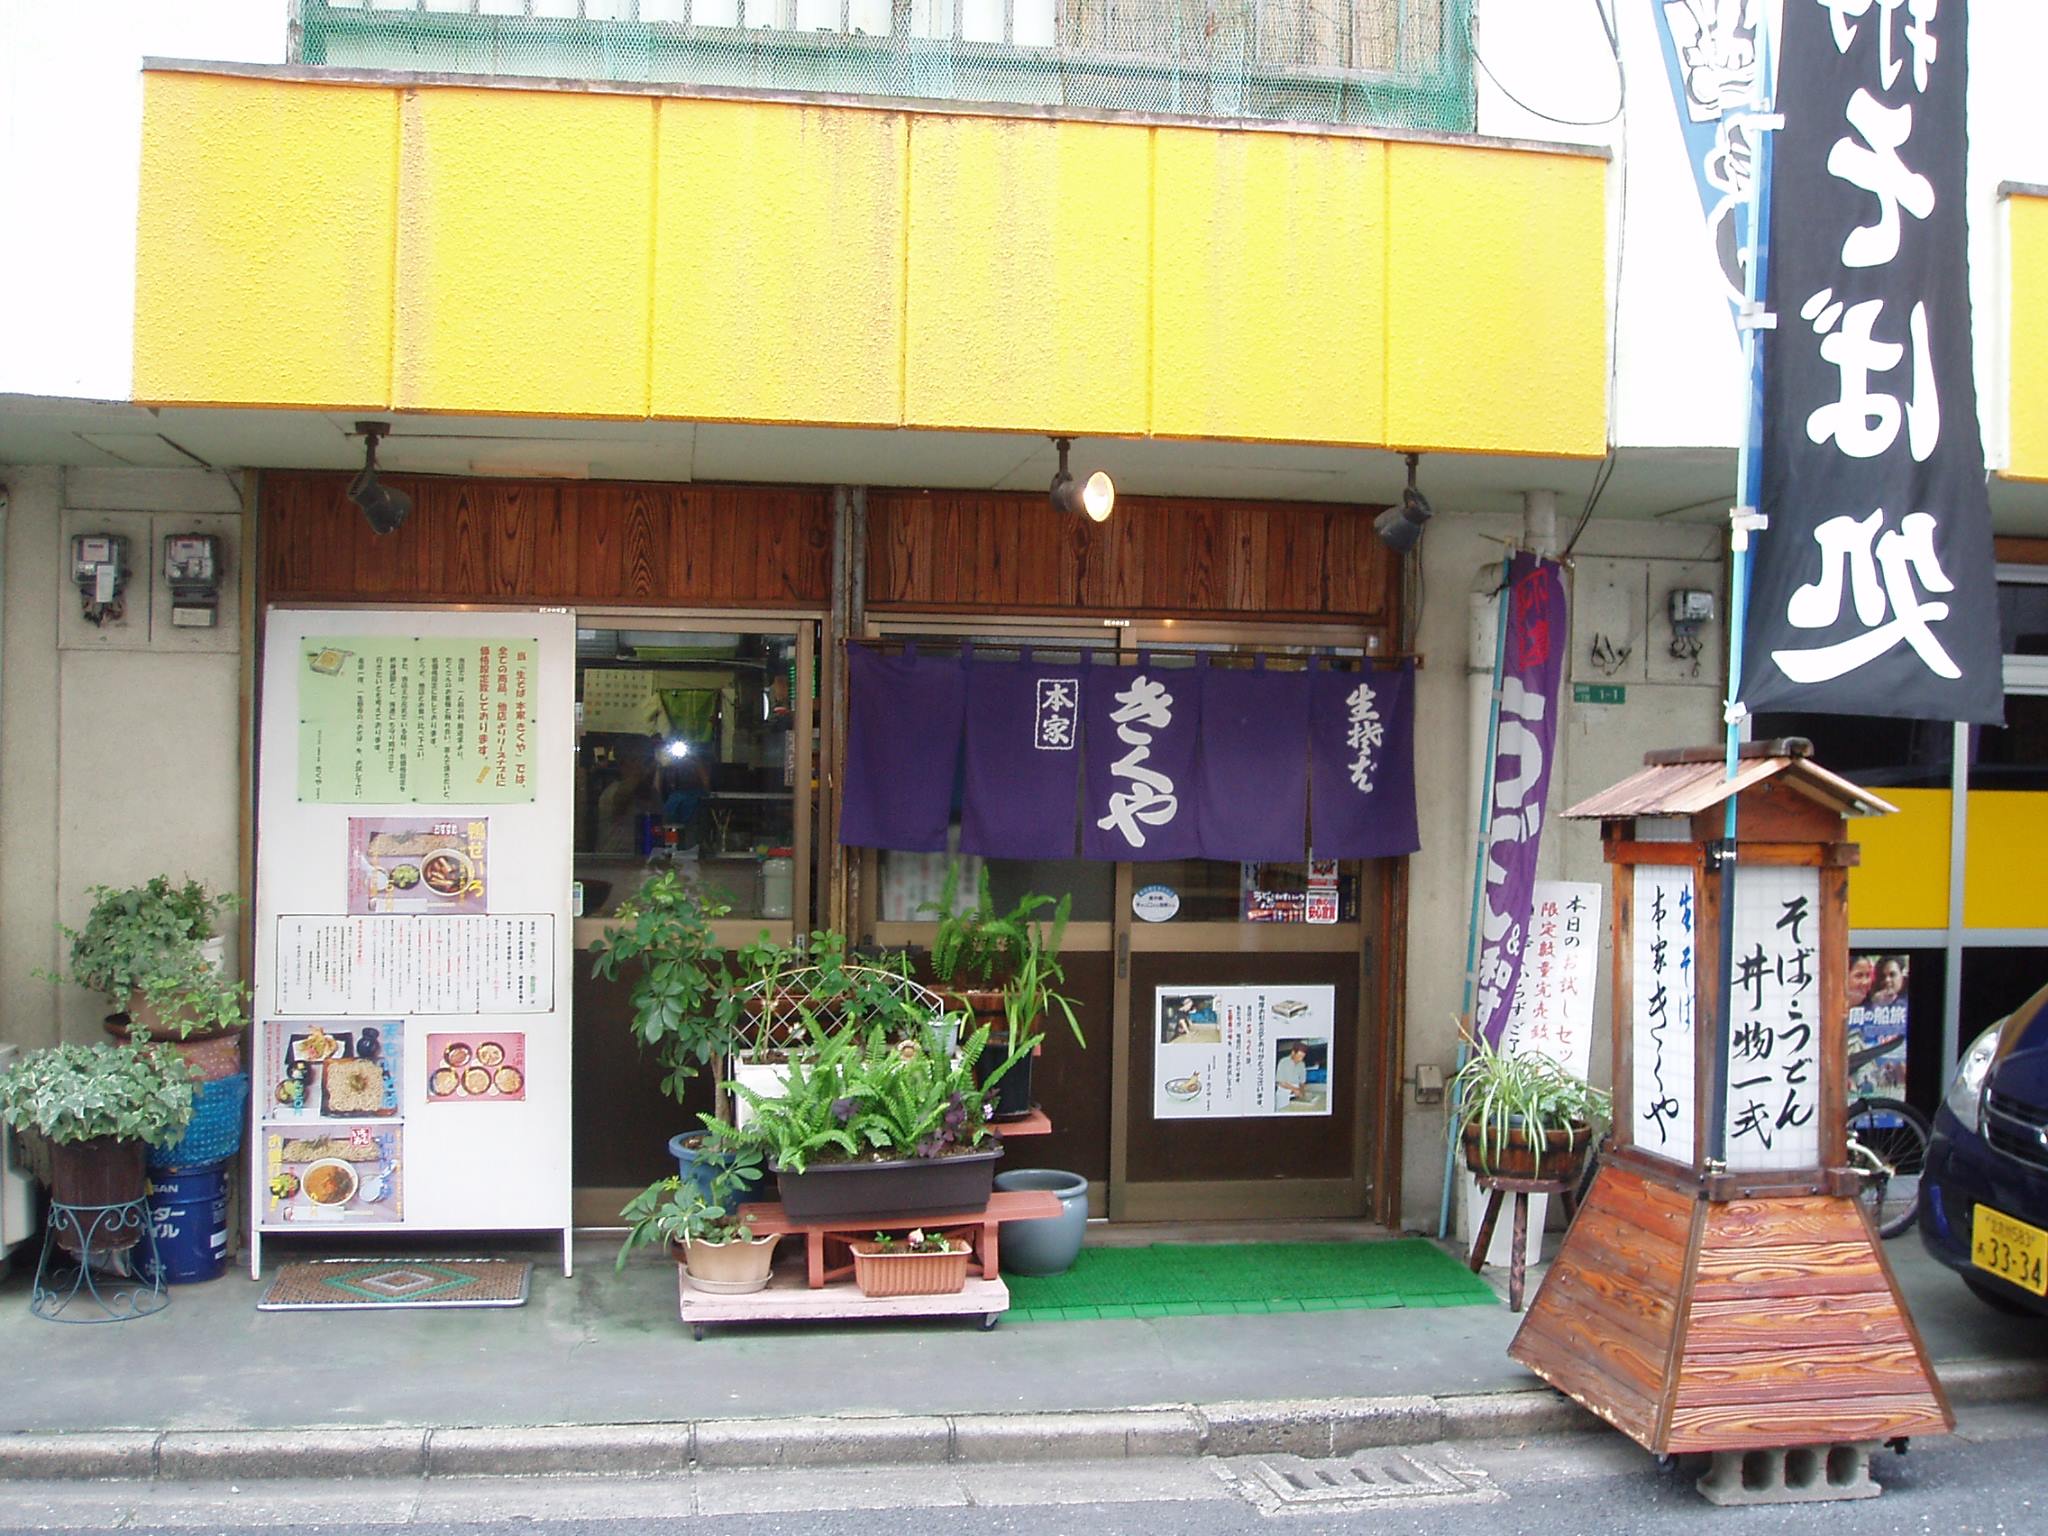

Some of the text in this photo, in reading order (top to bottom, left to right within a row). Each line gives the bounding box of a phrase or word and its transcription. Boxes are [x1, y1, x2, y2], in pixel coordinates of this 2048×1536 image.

[1043, 683, 1075, 745] 本家
[1097, 674, 1179, 849] きくや
[1988, 1237, 2042, 1289] 33-34
